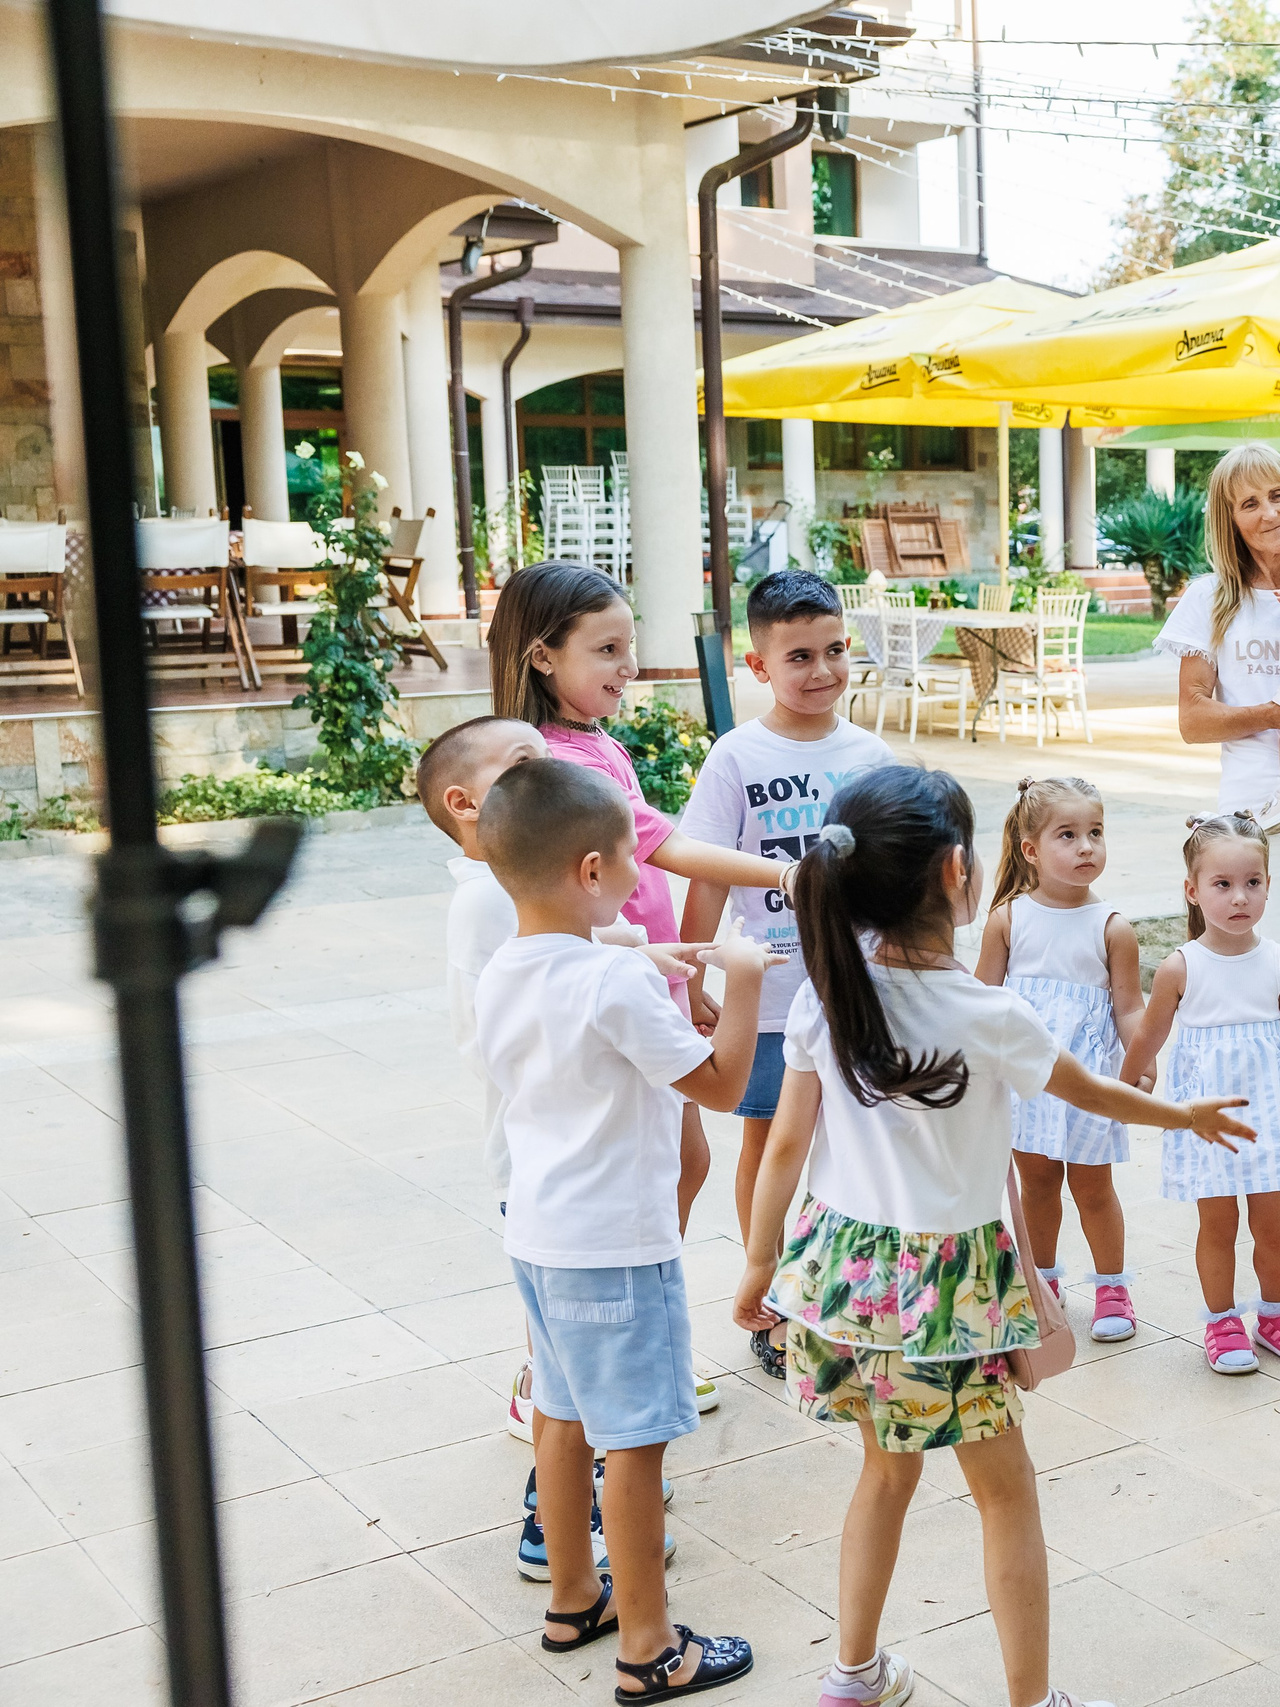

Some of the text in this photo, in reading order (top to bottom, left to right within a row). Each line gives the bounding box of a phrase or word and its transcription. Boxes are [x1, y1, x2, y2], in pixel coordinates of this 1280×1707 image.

[1176, 329, 1227, 361] Ариана
[745, 773, 820, 808] BOY,
[765, 926, 797, 939] JUST
